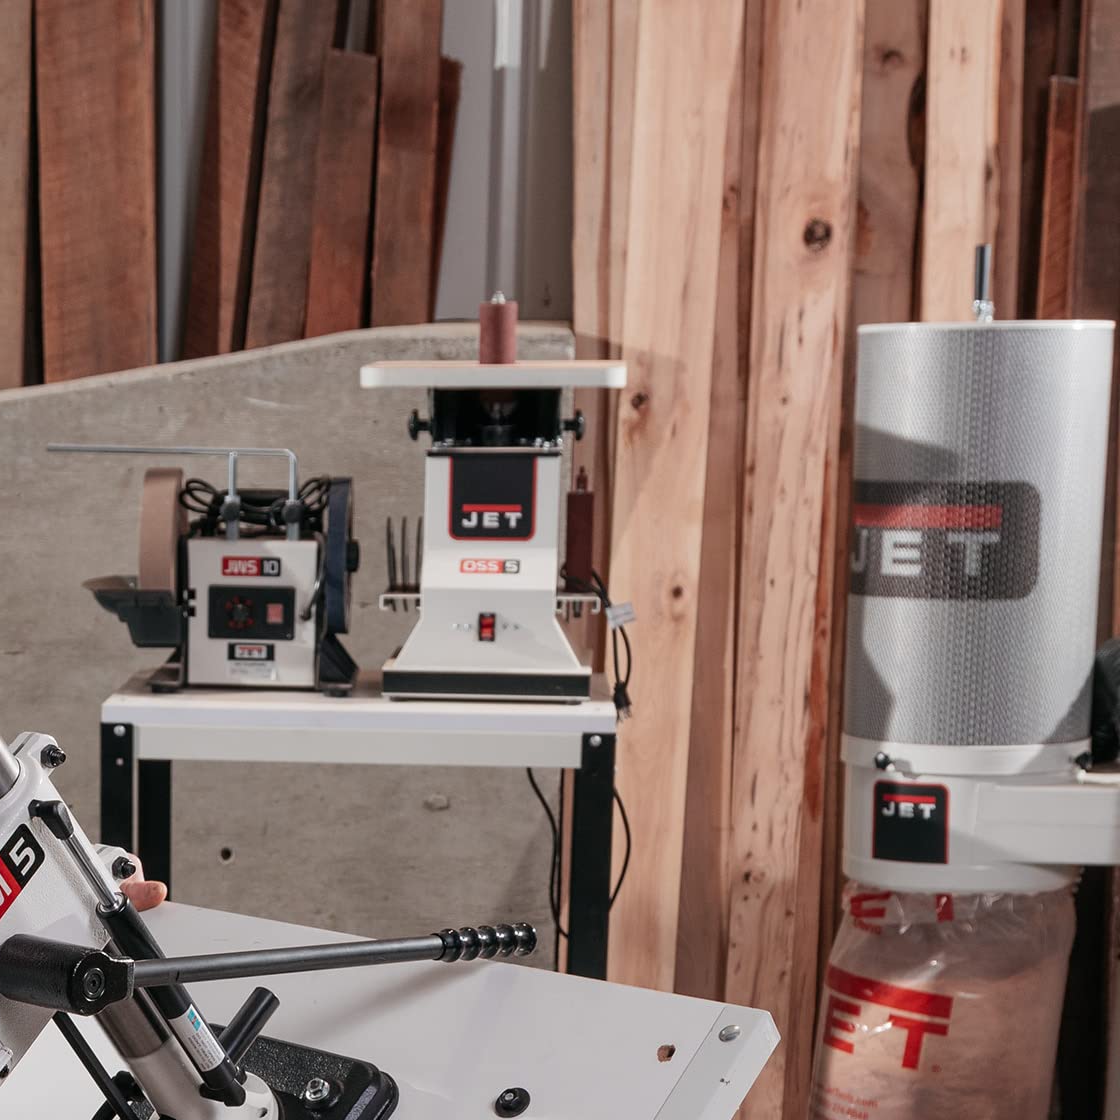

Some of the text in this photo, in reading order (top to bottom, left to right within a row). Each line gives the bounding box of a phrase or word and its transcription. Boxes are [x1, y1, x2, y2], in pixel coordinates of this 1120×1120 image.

[461, 511, 522, 528] JET
[851, 528, 1001, 577] JET
[223, 559, 280, 575] JWS 10
[462, 559, 499, 573] OSS
[882, 801, 936, 819] JET
[9, 837, 36, 876] 5
[823, 994, 950, 1070] ET
